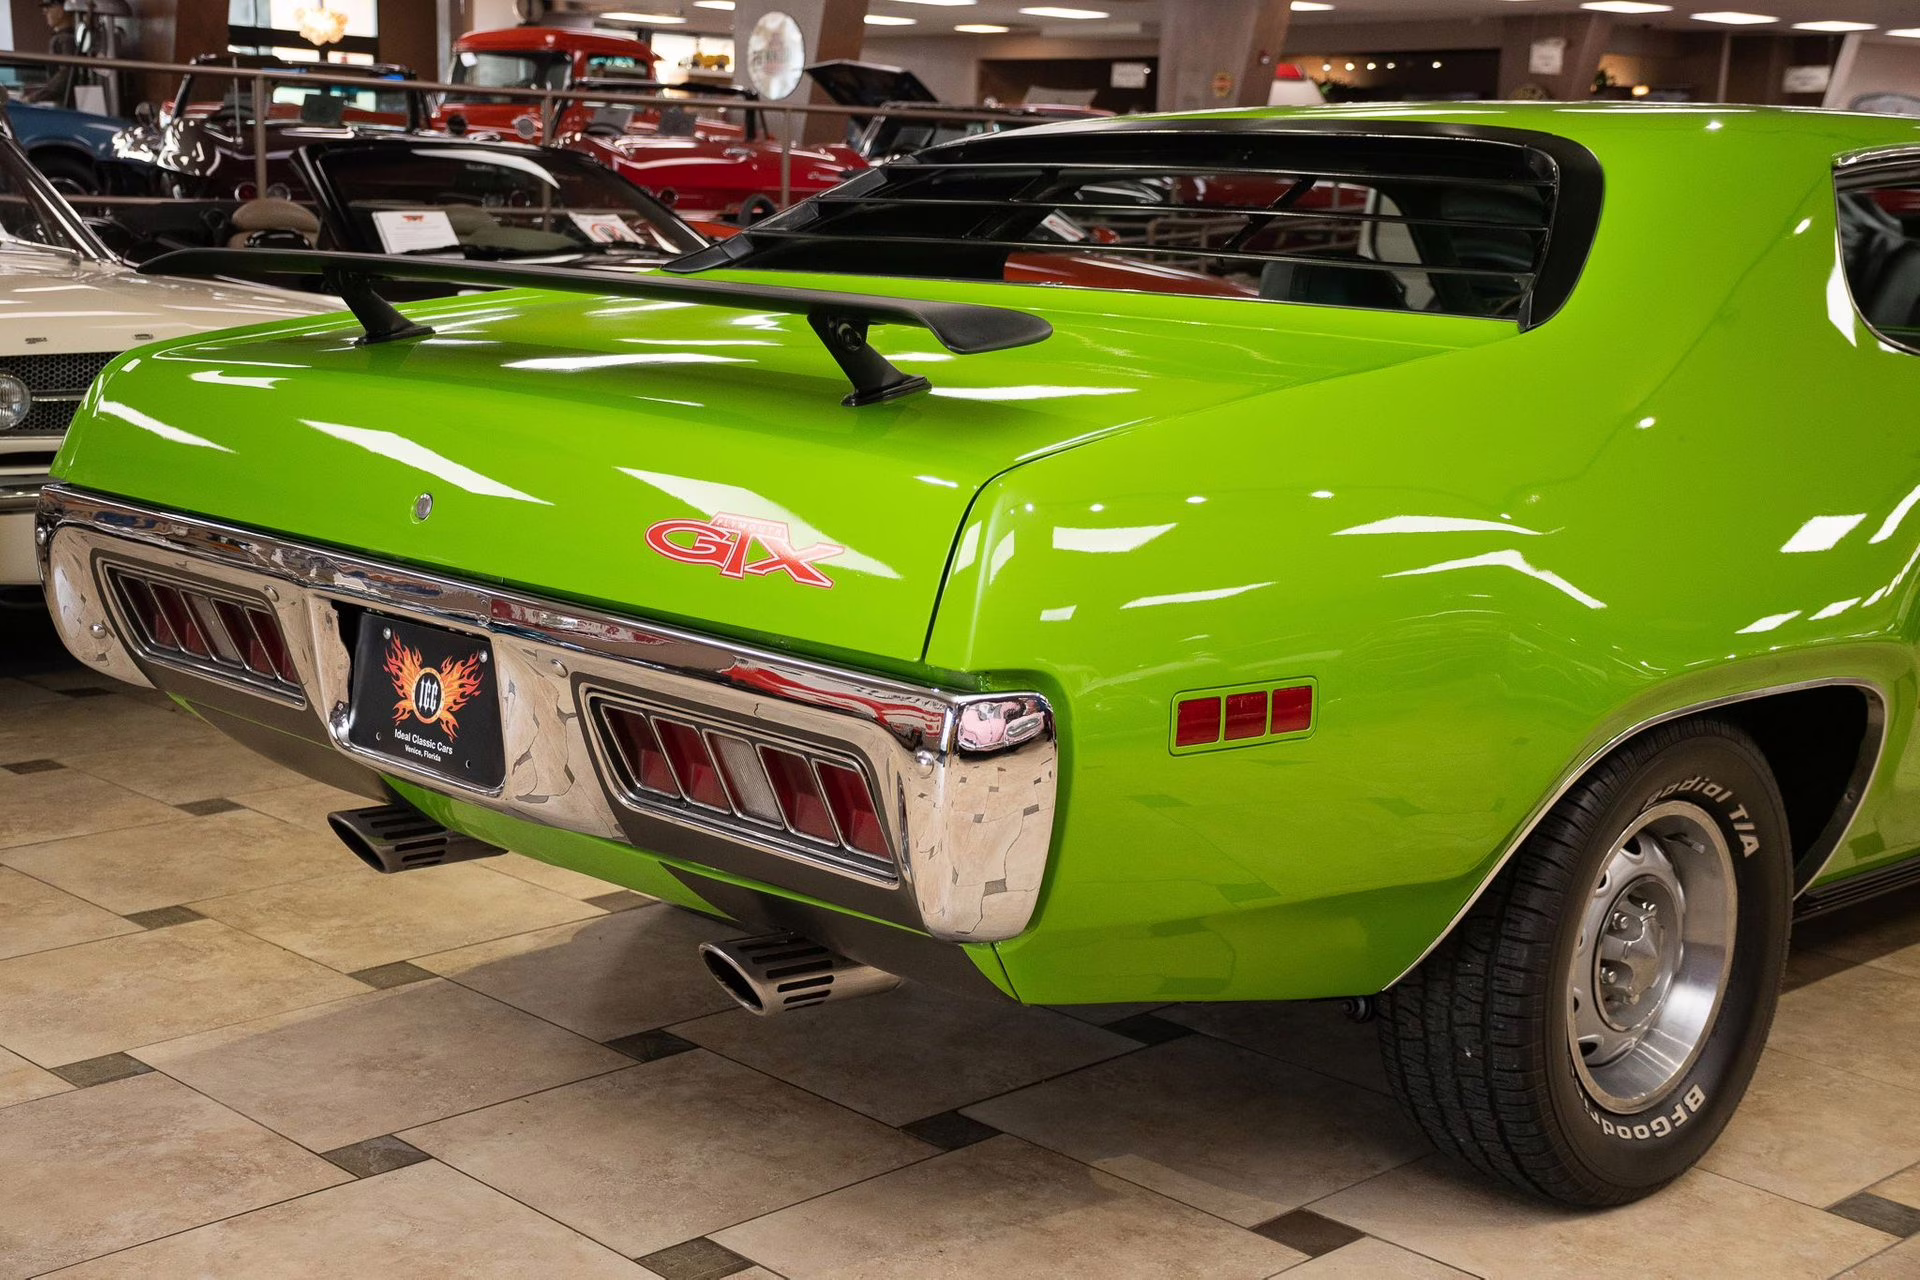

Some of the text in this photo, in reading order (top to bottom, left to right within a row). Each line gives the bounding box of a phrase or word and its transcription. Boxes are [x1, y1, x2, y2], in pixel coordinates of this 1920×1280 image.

[645, 512, 844, 589] GTX
[394, 729, 453, 755] Ideal Classic Cars
[405, 744, 441, 762] Venice, Florida
[1729, 804, 1760, 858] T/A
